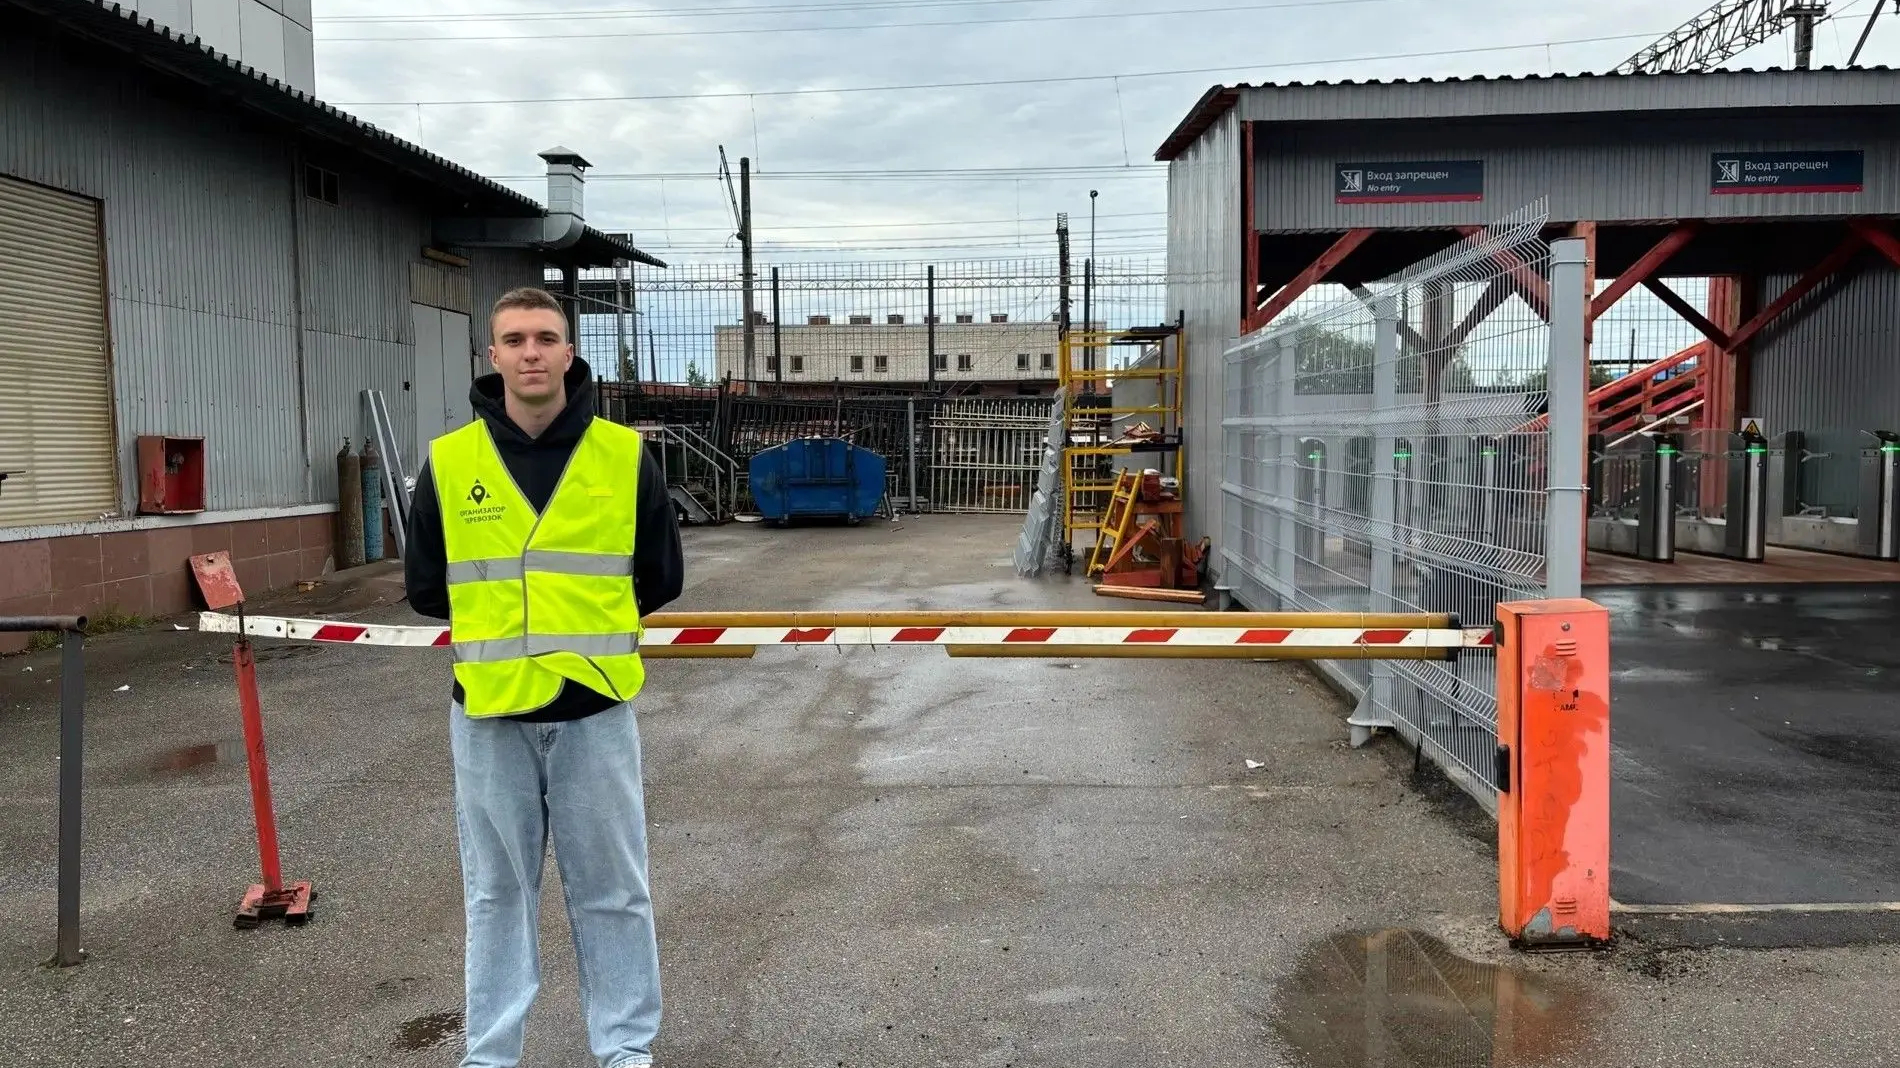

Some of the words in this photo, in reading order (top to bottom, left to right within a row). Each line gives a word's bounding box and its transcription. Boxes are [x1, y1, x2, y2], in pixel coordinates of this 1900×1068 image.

[1744, 161, 1771, 171] Вход
[1773, 160, 1829, 172] запрещен
[1367, 171, 1393, 181] Вход
[1394, 171, 1449, 182] запрещен
[1758, 175, 1780, 183] entry
[1367, 184, 1379, 192] No
[1380, 185, 1402, 193] entry
